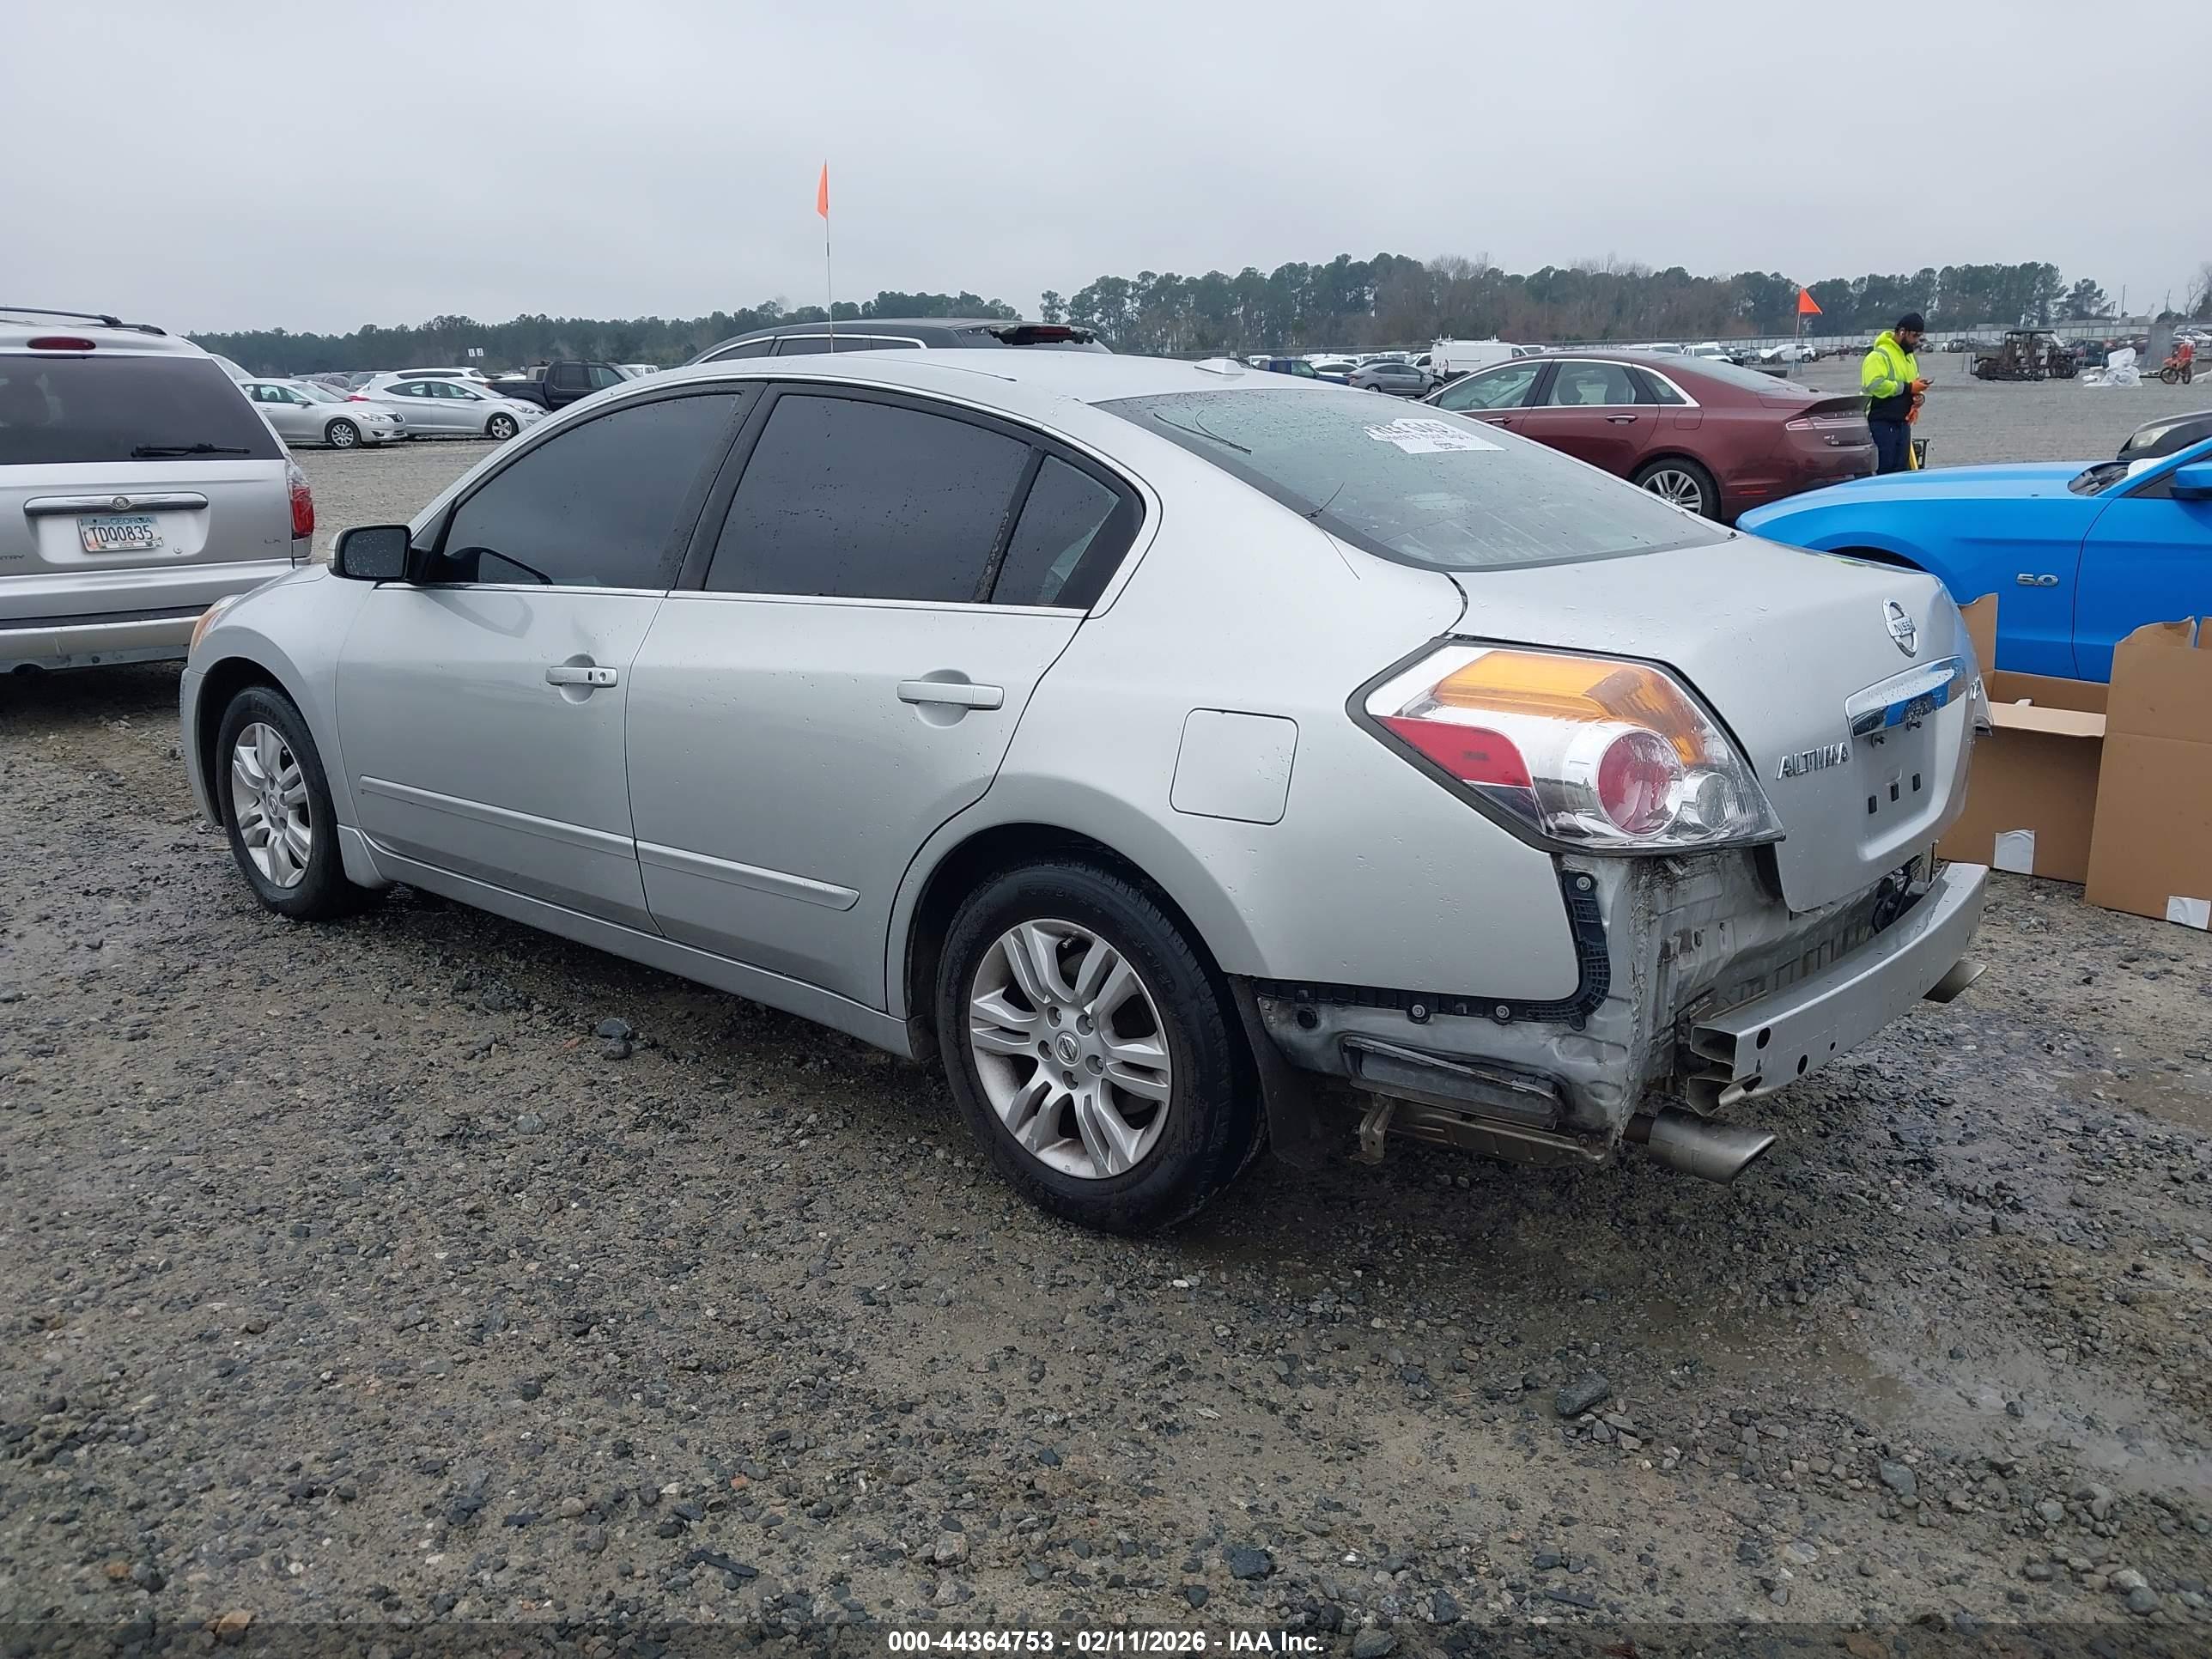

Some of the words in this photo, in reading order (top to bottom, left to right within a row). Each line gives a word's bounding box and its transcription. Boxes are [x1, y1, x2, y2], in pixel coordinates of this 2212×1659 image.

[110, 517, 153, 526] GEORGIA
[88, 525, 154, 543] TDQ0835
[2016, 573, 2059, 586] 5.0
